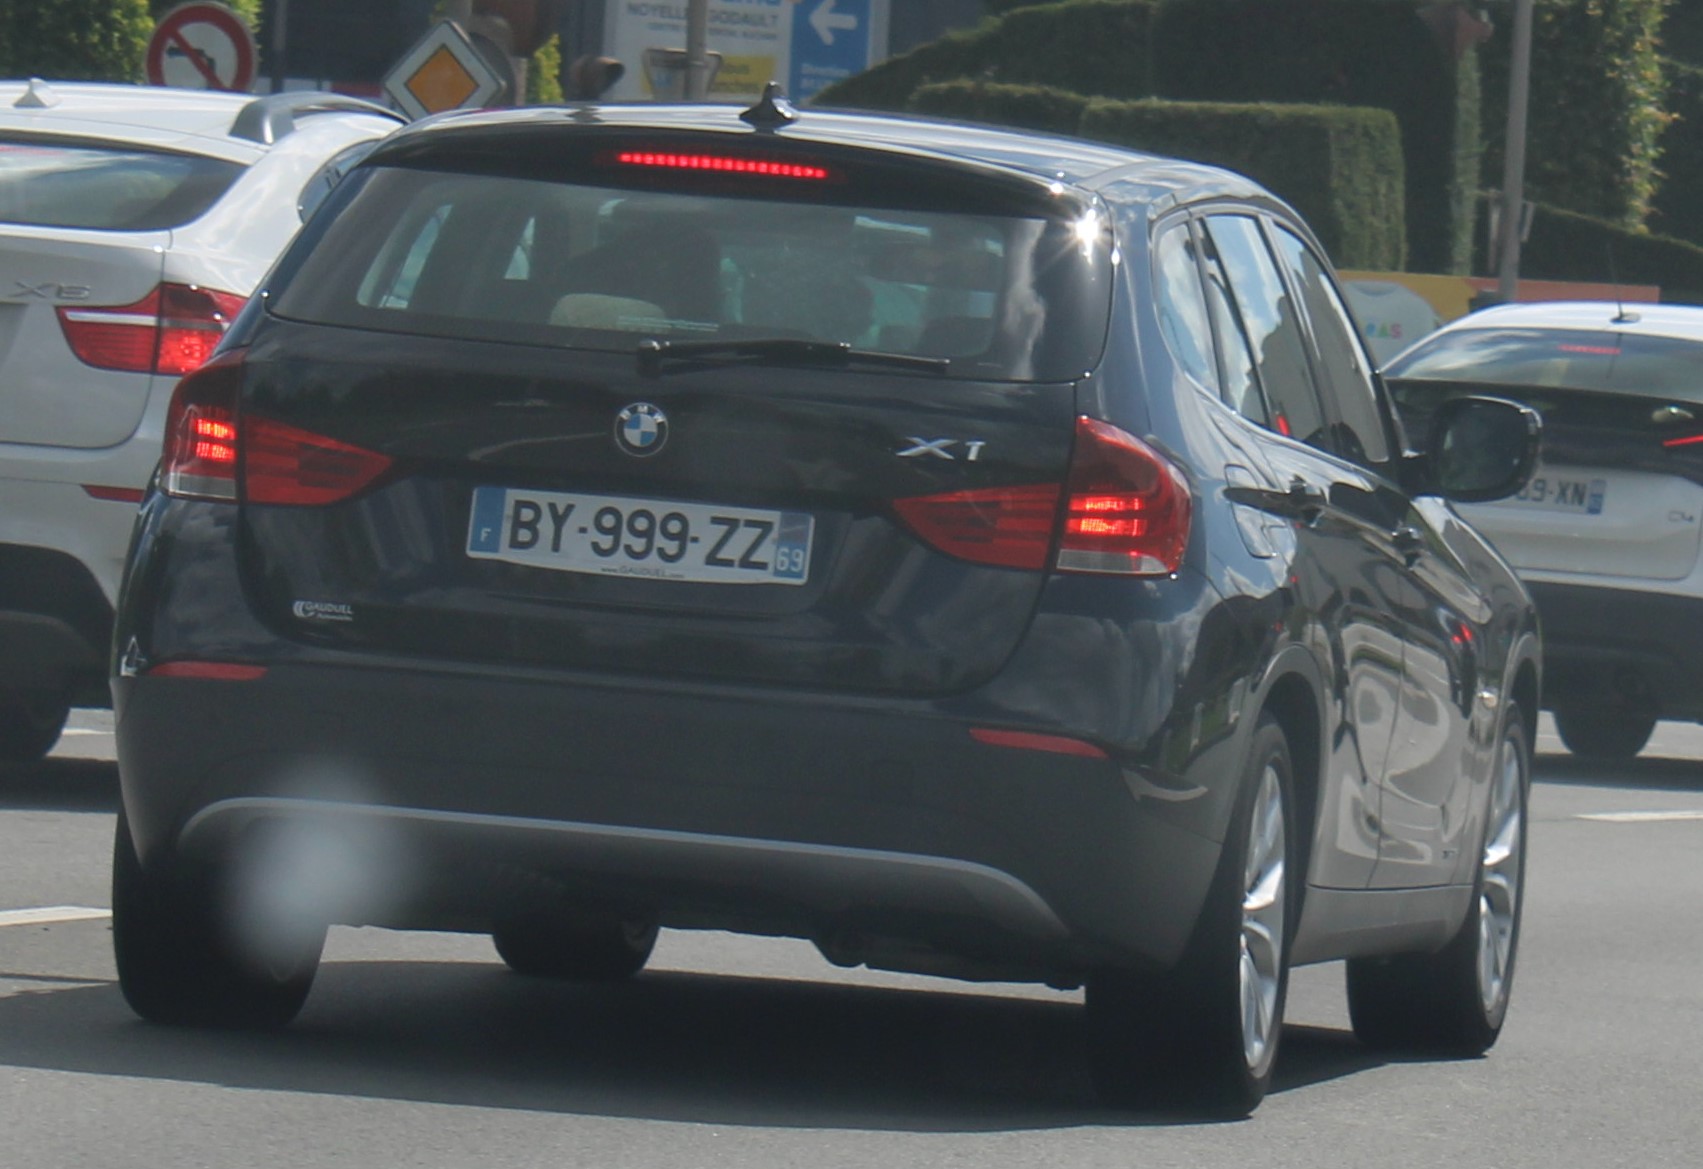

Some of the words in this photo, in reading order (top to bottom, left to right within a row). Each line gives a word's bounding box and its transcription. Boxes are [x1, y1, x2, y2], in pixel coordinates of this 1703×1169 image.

[7, 280, 91, 301] X6
[620, 405, 666, 424] BMW
[895, 436, 987, 461] X1
[479, 527, 491, 542] F
[507, 499, 775, 571] BY-999-ZZ
[776, 548, 802, 572] 69
